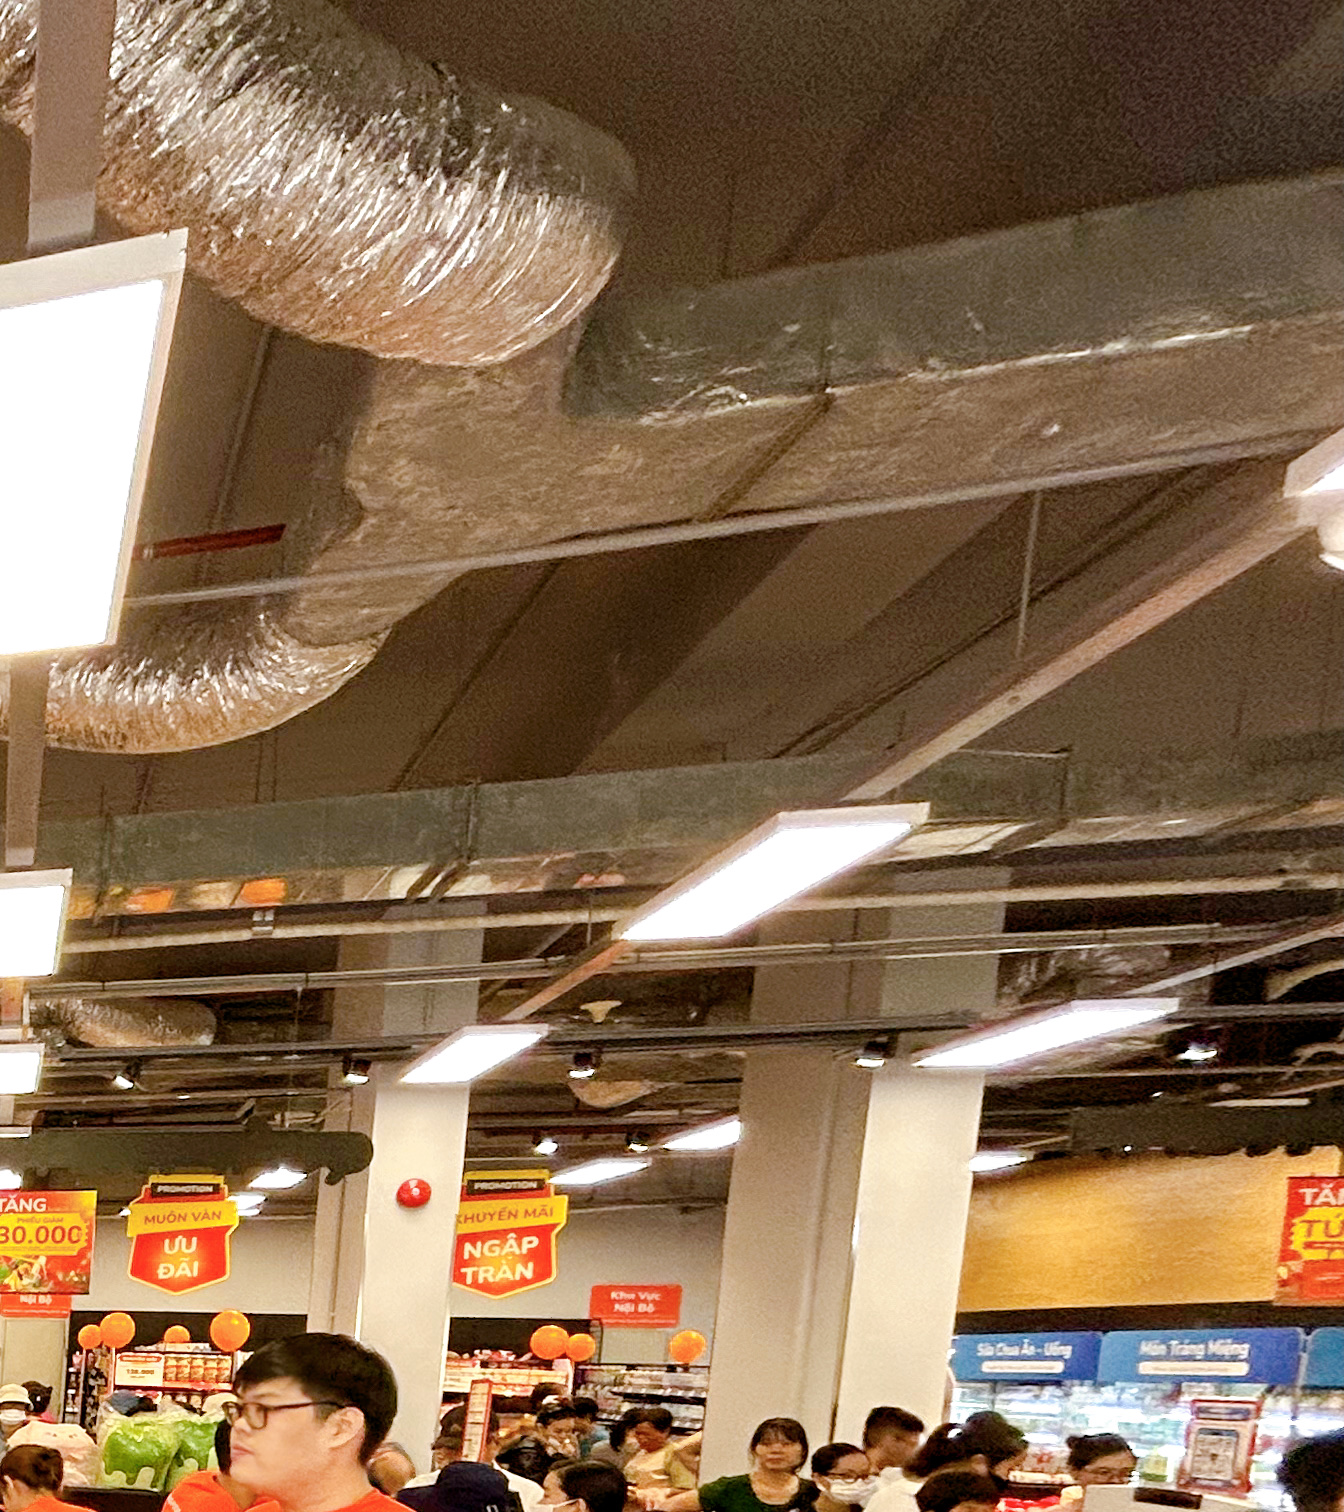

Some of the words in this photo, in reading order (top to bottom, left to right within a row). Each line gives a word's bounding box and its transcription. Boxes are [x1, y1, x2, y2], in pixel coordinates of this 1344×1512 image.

[157, 1185, 213, 1193] PROMOTION
[474, 1181, 538, 1190] PROMOTION
[523, 1204, 554, 1218] MÃI
[163, 1235, 198, 1254] ƯU
[463, 1232, 540, 1260] NGẬP
[157, 1257, 199, 1280] ĐÃI
[460, 1260, 534, 1285] TRÀN
